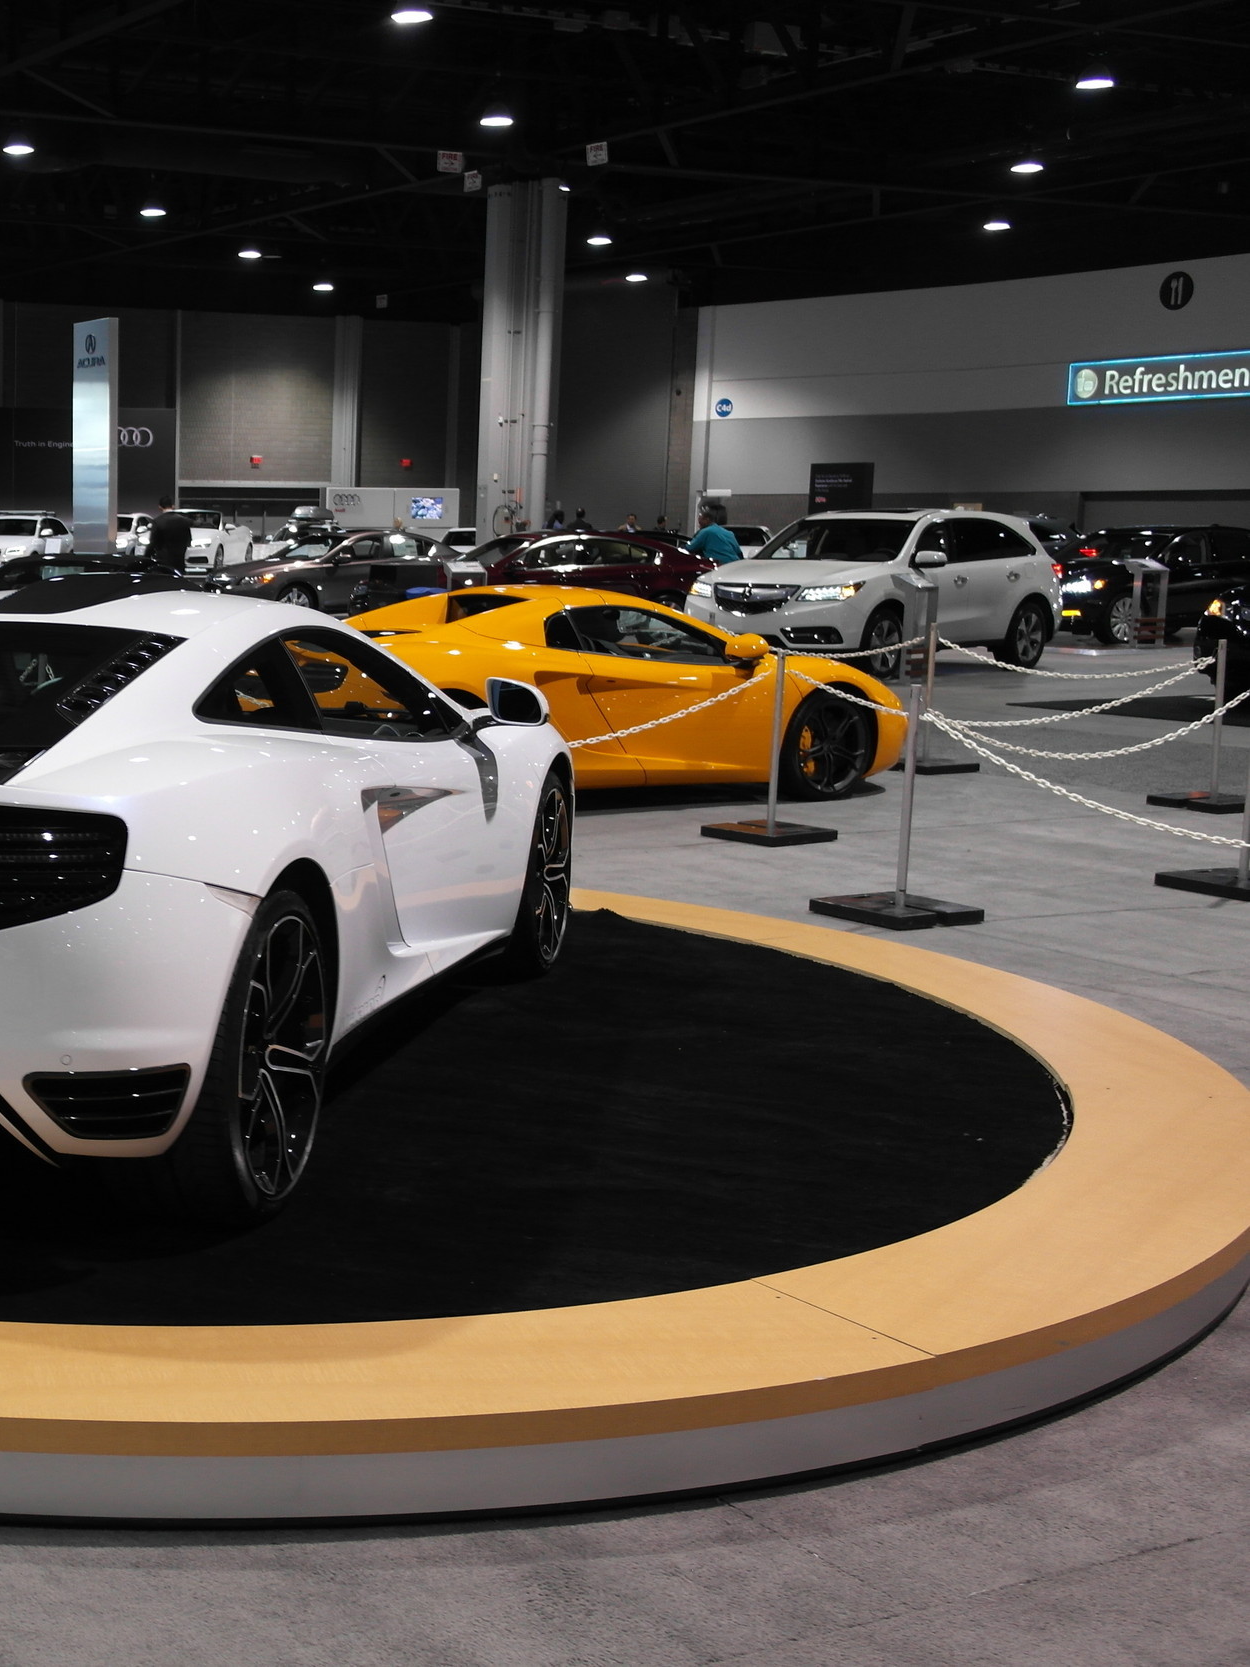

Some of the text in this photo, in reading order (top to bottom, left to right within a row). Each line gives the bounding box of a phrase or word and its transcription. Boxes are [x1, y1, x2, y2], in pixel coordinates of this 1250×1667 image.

[441, 152, 458, 161] FIRE
[77, 356, 106, 369] ACURA
[1103, 364, 1250, 395] Refreshmen
[716, 403, 732, 413] C4d
[13, 440, 36, 448] Truth
[38, 440, 45, 448] in
